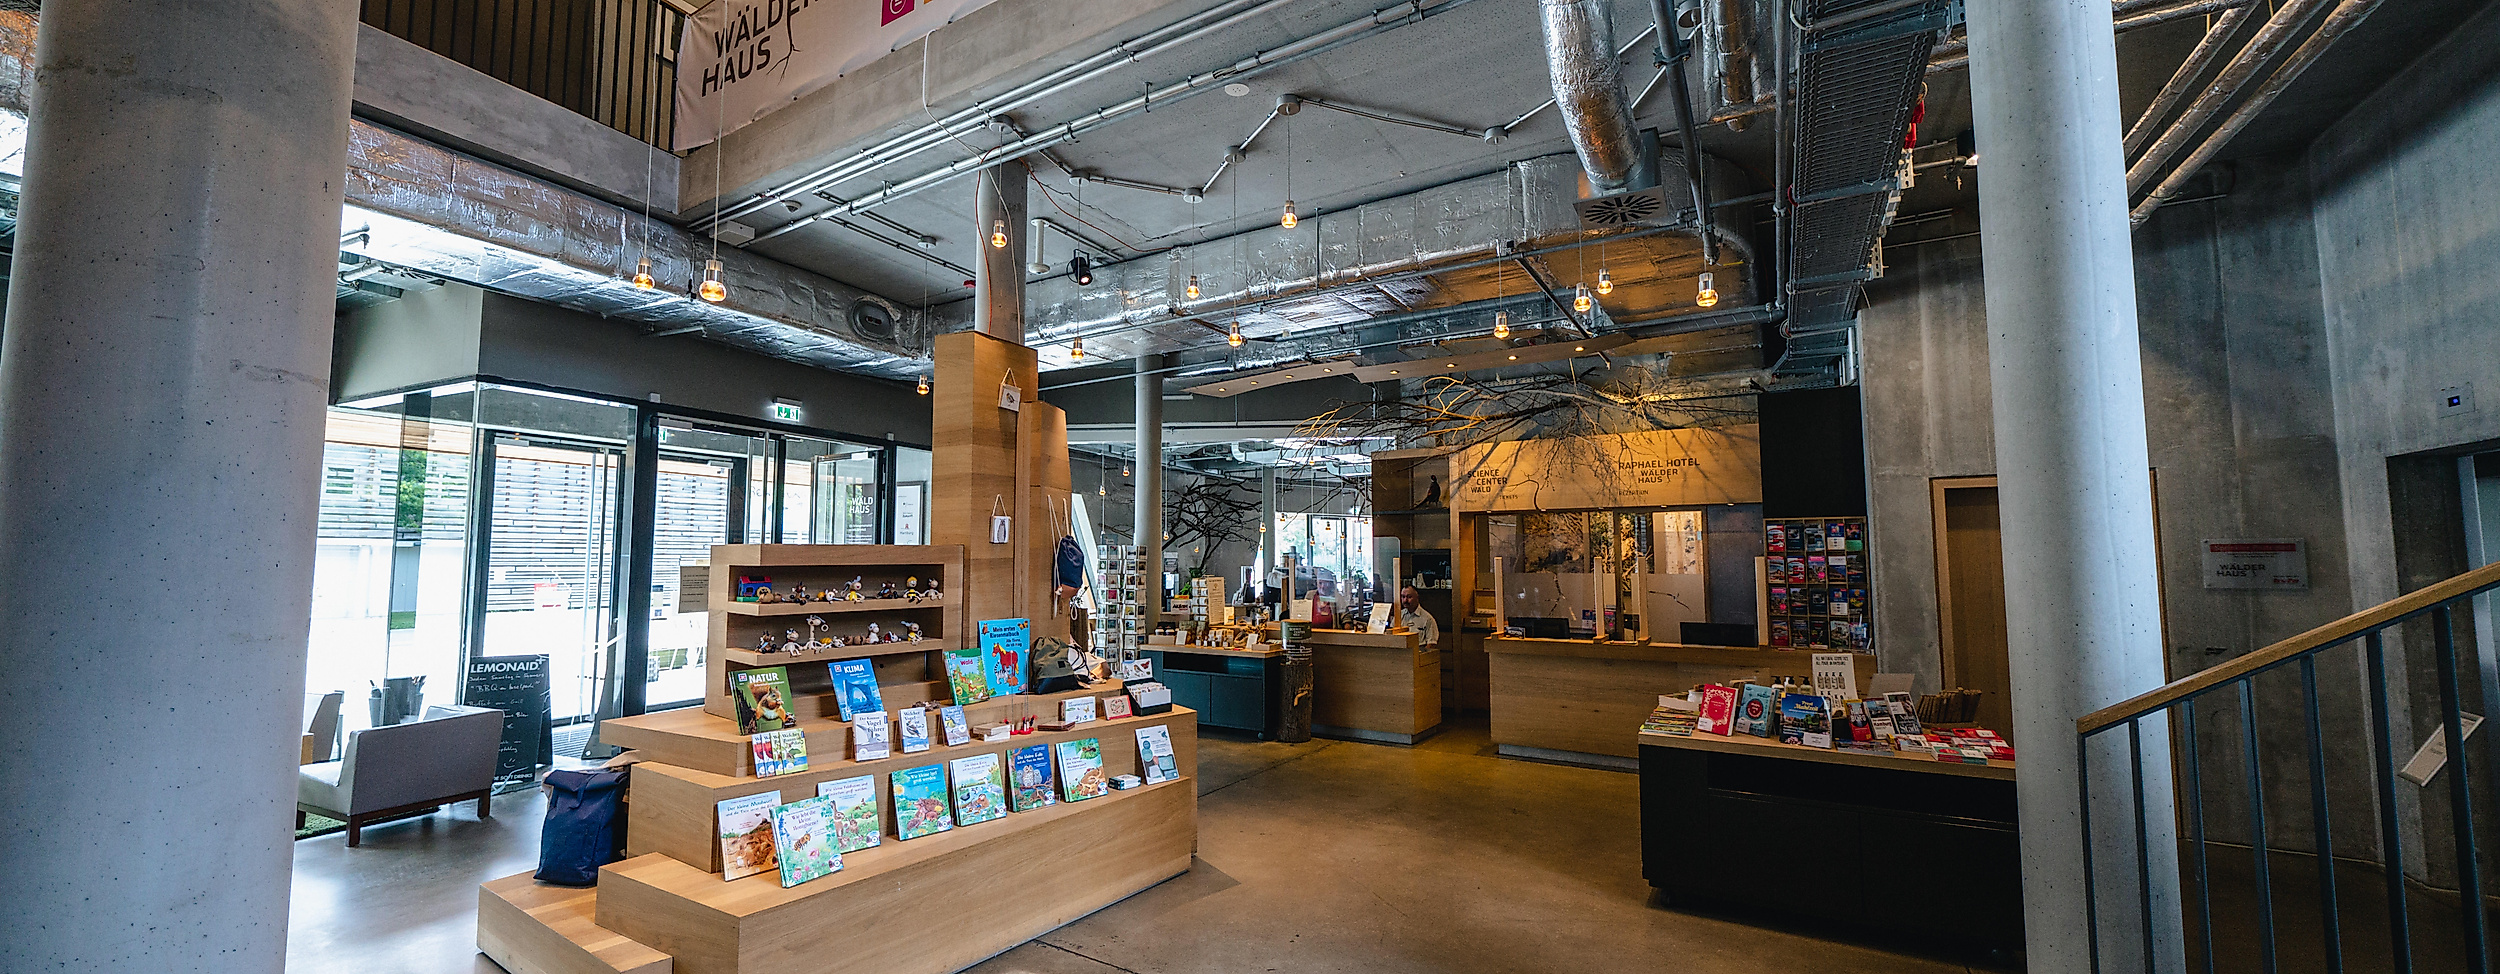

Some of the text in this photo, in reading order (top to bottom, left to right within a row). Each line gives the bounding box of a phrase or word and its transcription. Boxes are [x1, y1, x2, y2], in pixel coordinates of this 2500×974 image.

[714, 0, 818, 58] WÄLDE
[702, 35, 770, 97] HAUS
[1618, 457, 1700, 470] RAPHAEL HOTEL
[1467, 469, 1500, 479] SCIENCE
[1640, 468, 1678, 476] WÄLDER
[1476, 477, 1508, 486] CENTER
[1638, 476, 1663, 484] HAUS
[849, 505, 870, 514] HAUS
[843, 664, 865, 674] KLIMA
[748, 672, 779, 684] NATUR
